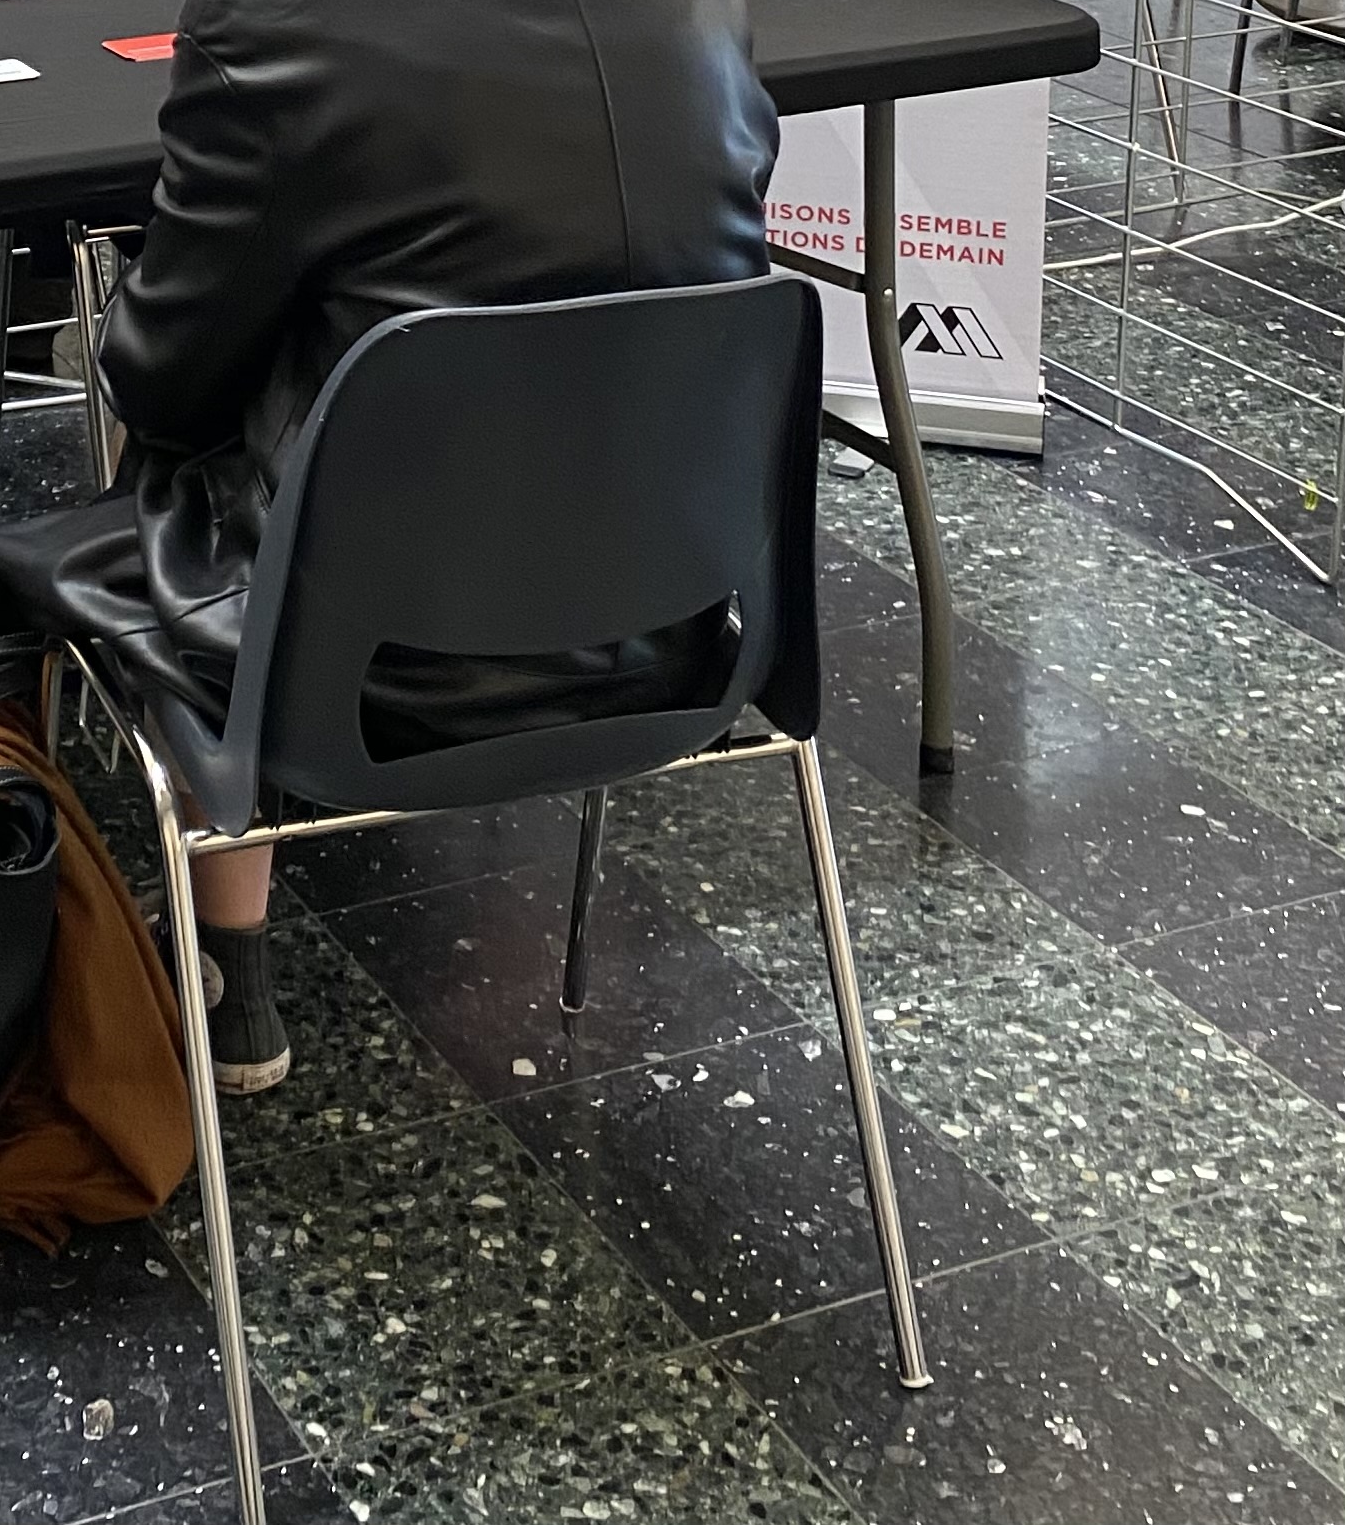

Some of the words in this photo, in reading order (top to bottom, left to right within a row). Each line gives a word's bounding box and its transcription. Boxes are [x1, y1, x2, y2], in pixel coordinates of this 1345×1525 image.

[761, 202, 850, 225] ISONS
[900, 214, 1007, 240] SEMBLE
[900, 240, 1004, 266] DEMAIN
